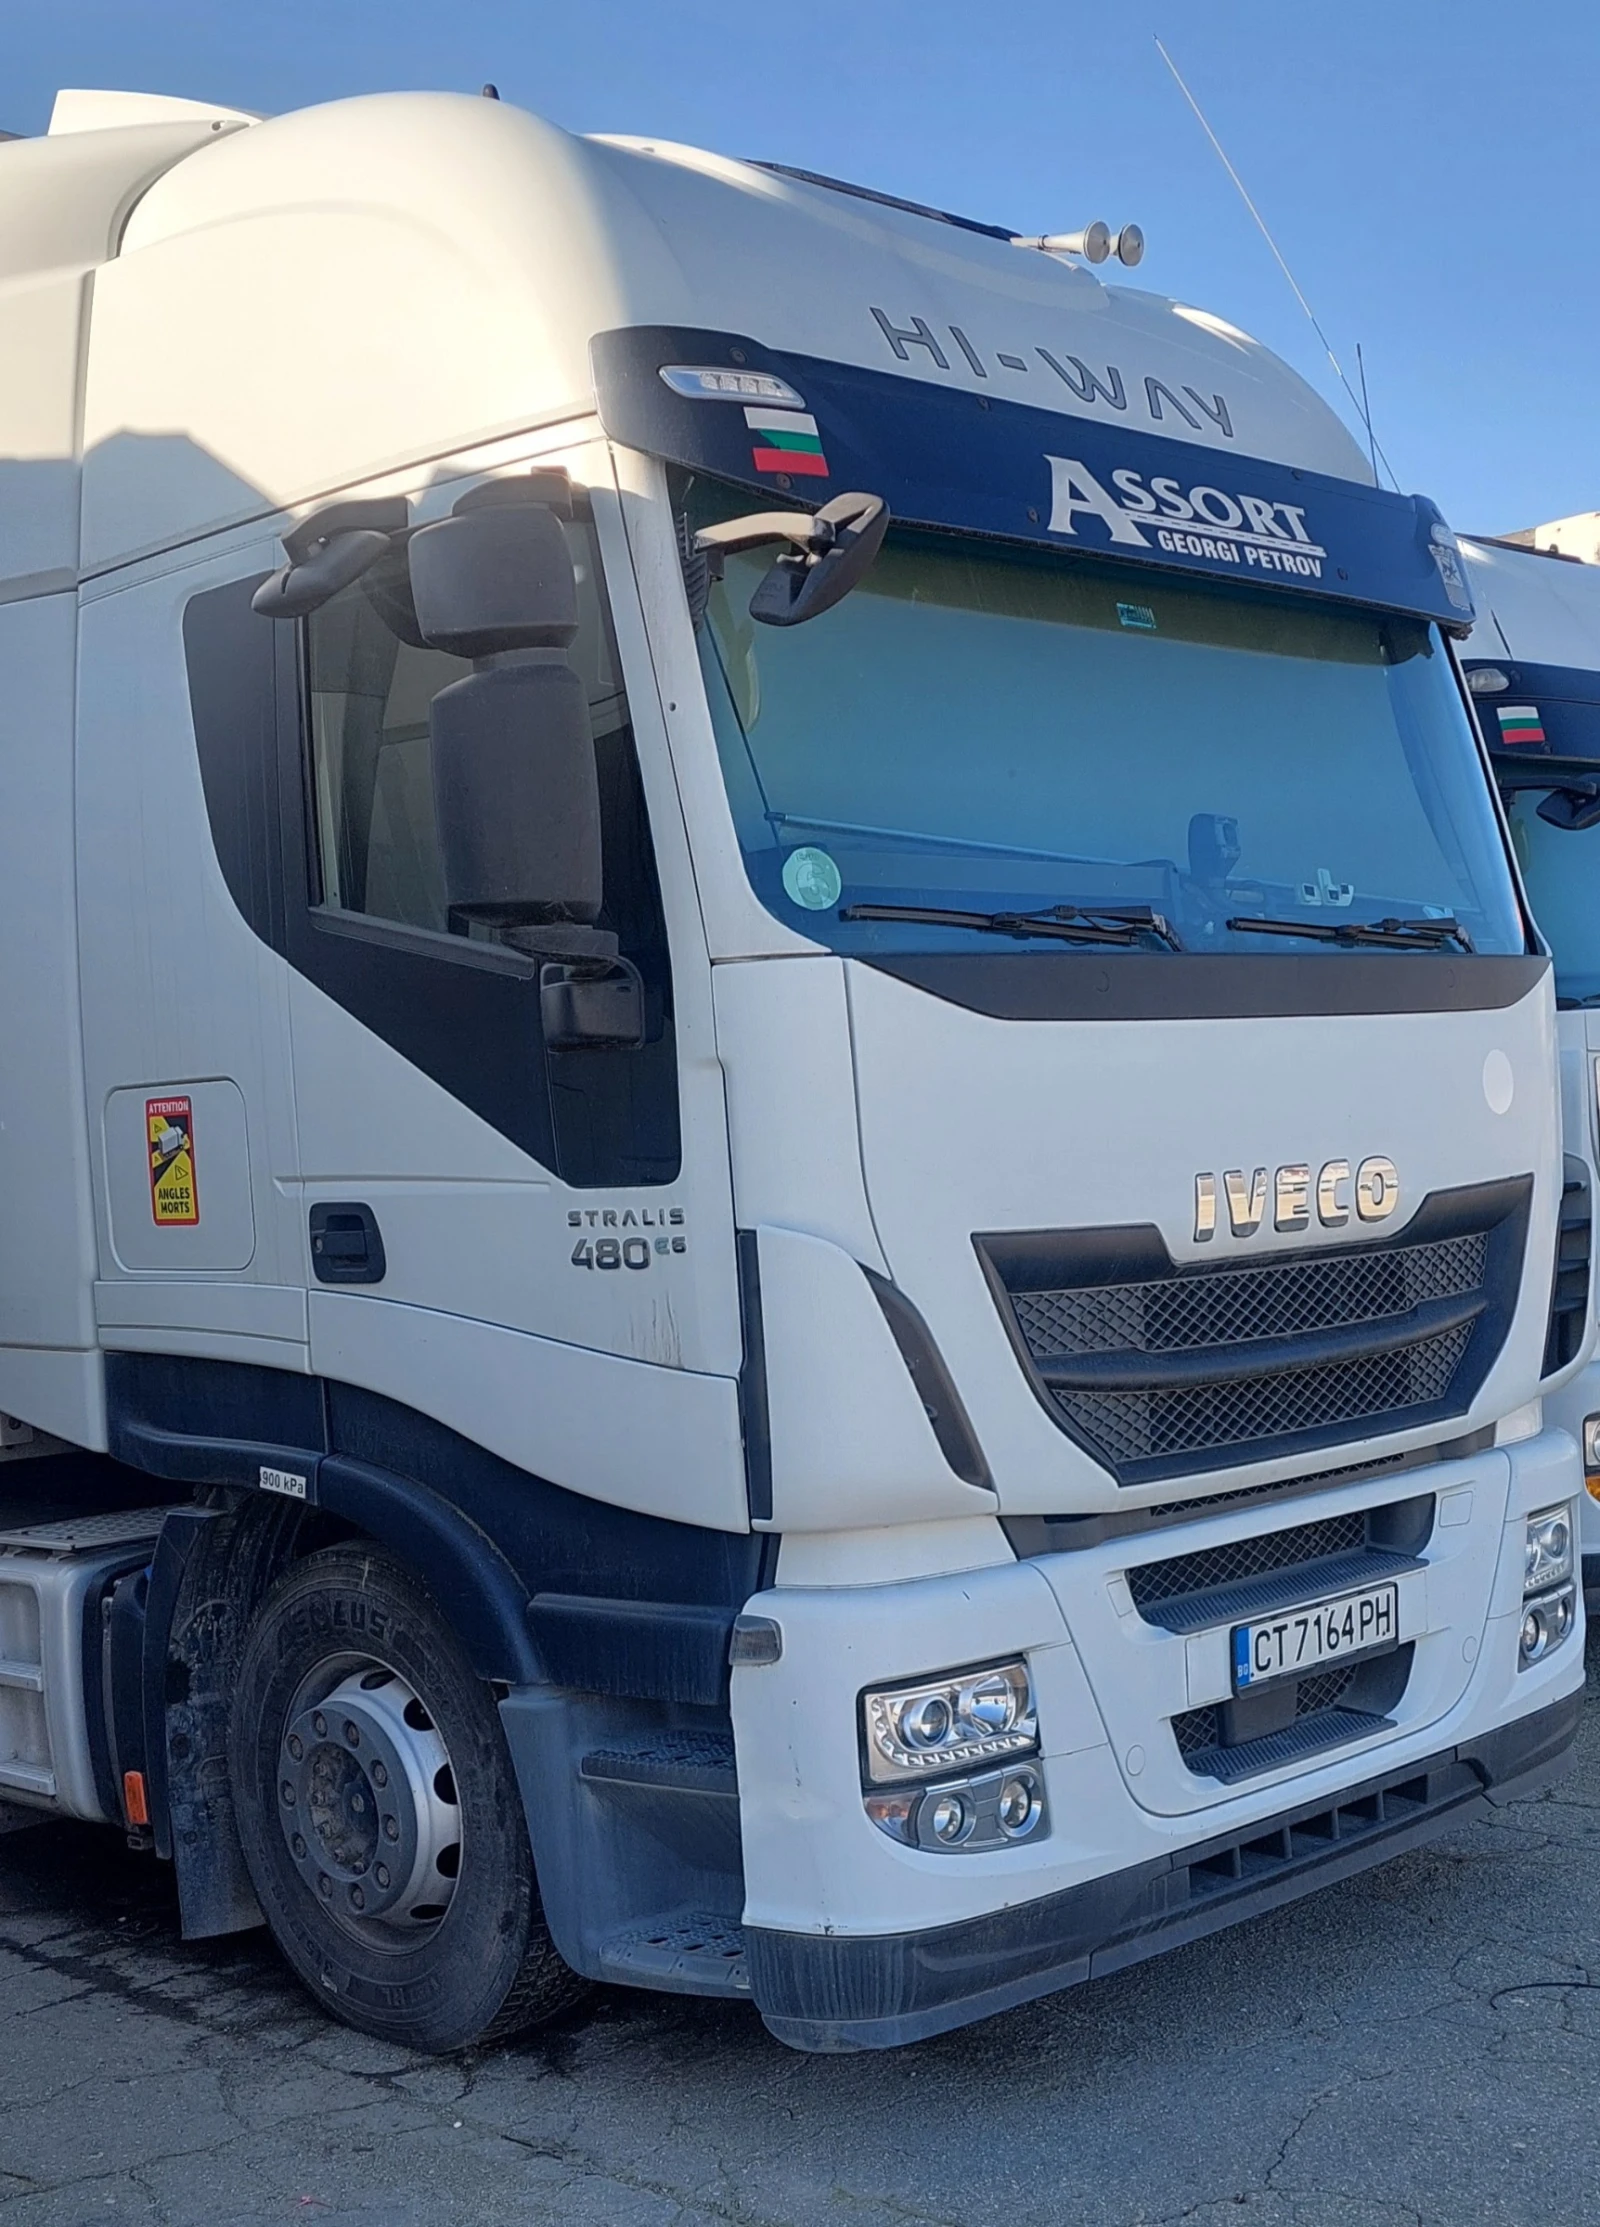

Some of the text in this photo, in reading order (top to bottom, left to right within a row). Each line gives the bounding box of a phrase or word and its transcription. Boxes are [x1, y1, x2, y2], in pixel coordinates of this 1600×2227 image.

[869, 306, 1234, 438] HI-WAY
[1043, 454, 1312, 548] ASSORT
[1157, 530, 1322, 578] GEORGI PETROV
[149, 1101, 189, 1114] ATTENTION
[158, 1187, 191, 1200] ANGLES
[1193, 1155, 1399, 1243] IVECO
[160, 1202, 191, 1214] MORTS
[567, 1207, 685, 1228] STRALIS
[571, 1237, 651, 1270] 480
[262, 1470, 304, 1494] 900 kPa
[1237, 1663, 1249, 1678] BG
